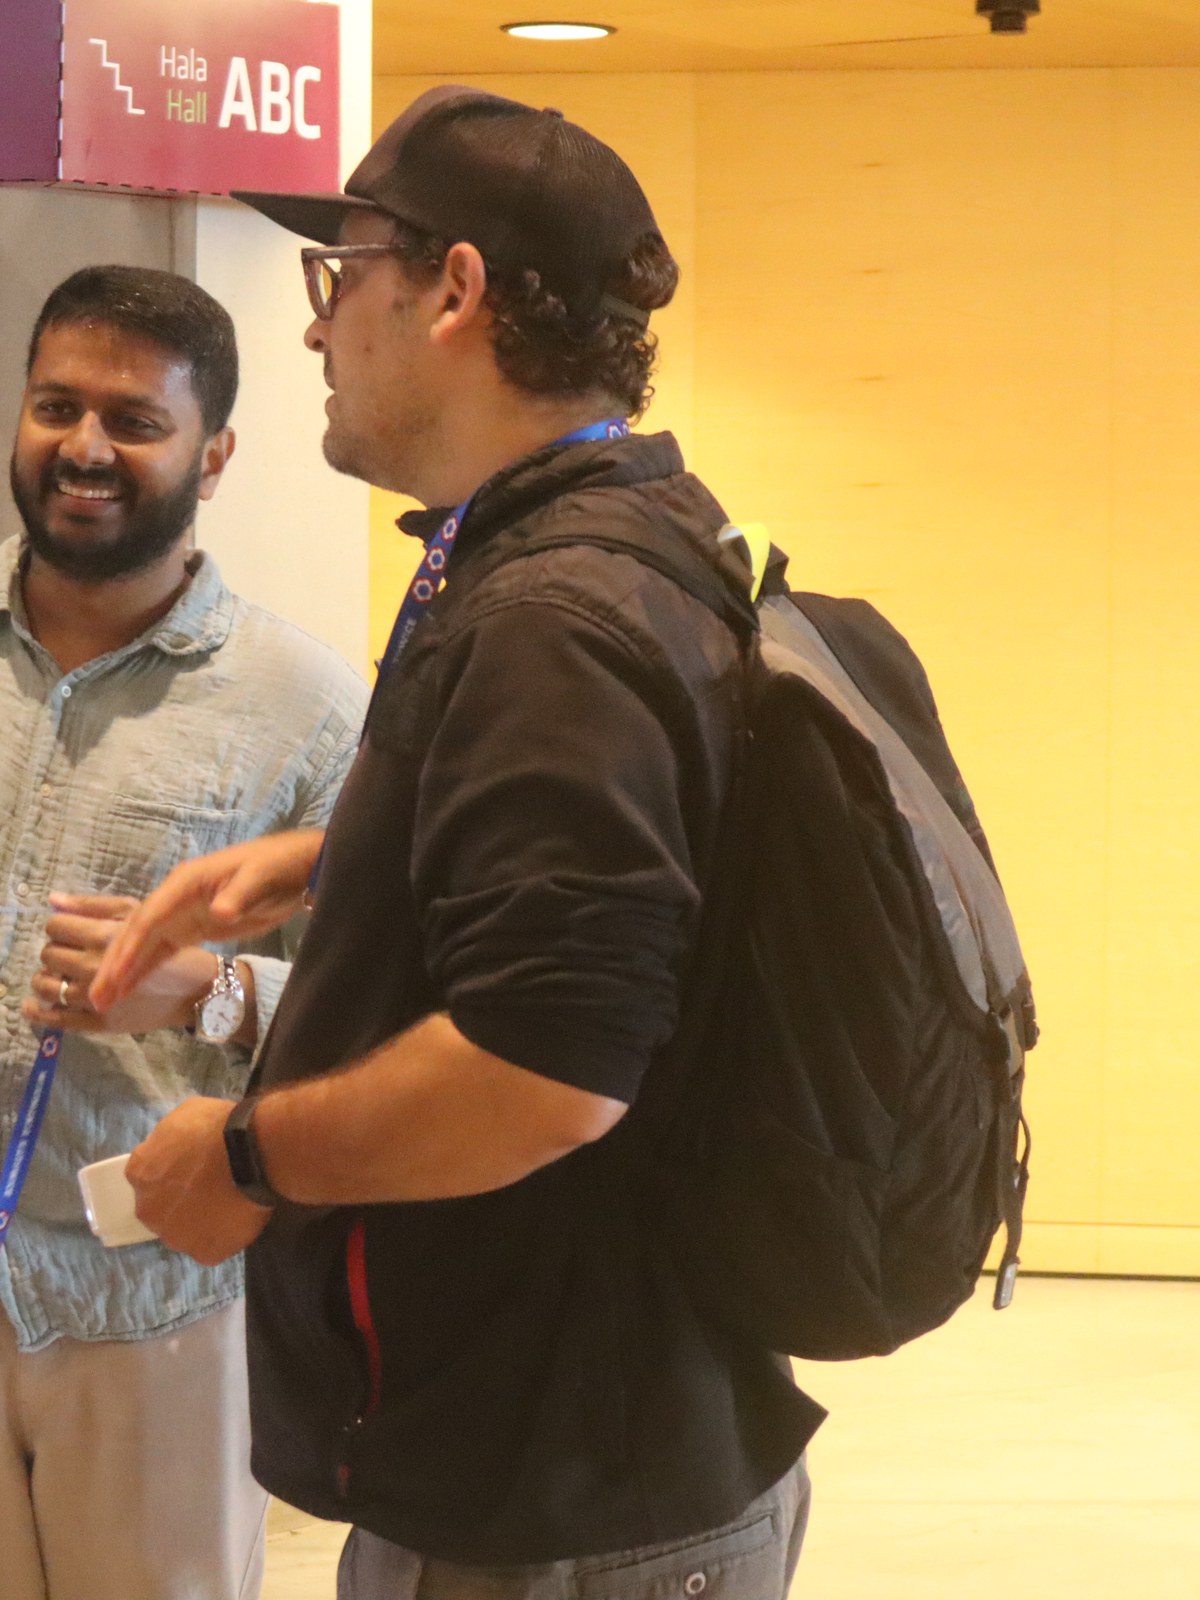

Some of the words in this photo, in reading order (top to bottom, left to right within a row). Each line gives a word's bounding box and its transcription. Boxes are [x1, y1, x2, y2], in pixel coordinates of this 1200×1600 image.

[160, 45, 207, 82] Hala
[166, 88, 207, 124] Hall
[218, 56, 322, 139] ABC
